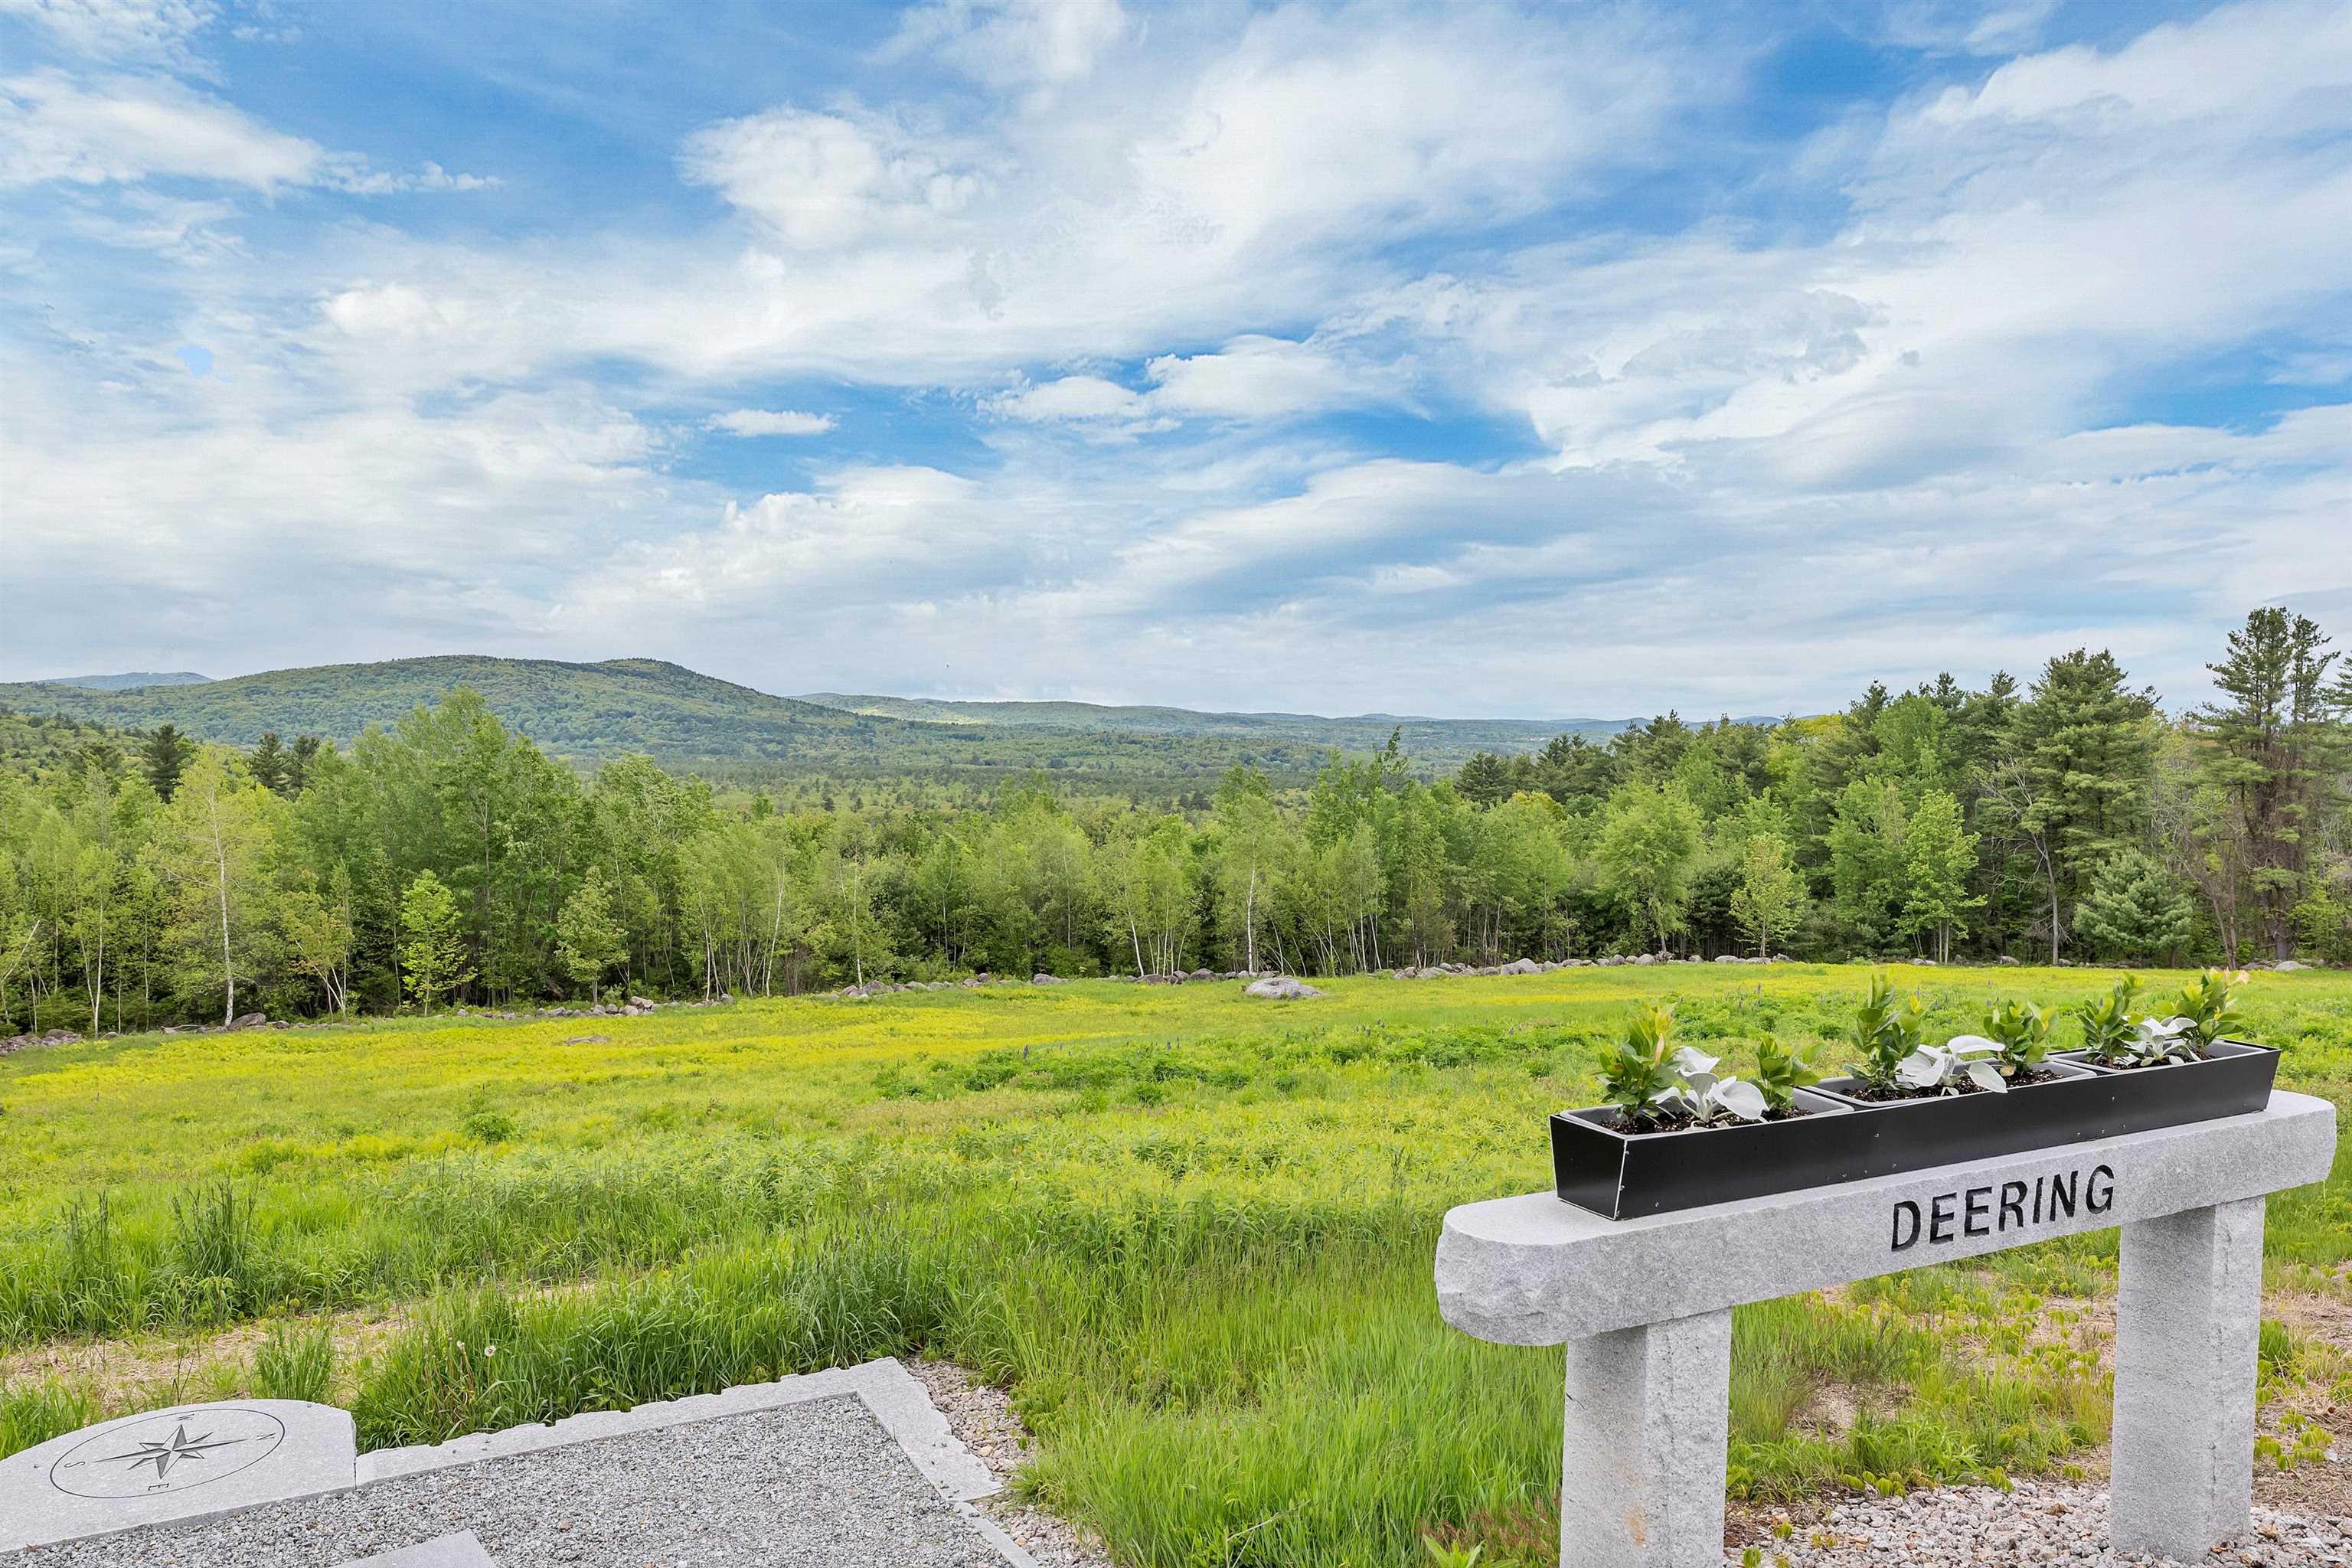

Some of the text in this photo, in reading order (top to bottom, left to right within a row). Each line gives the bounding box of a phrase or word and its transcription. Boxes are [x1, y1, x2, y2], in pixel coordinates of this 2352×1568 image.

[1891, 1165, 2115, 1252] DEERING
[256, 1432, 276, 1441] N
[148, 1483, 169, 1491] E
